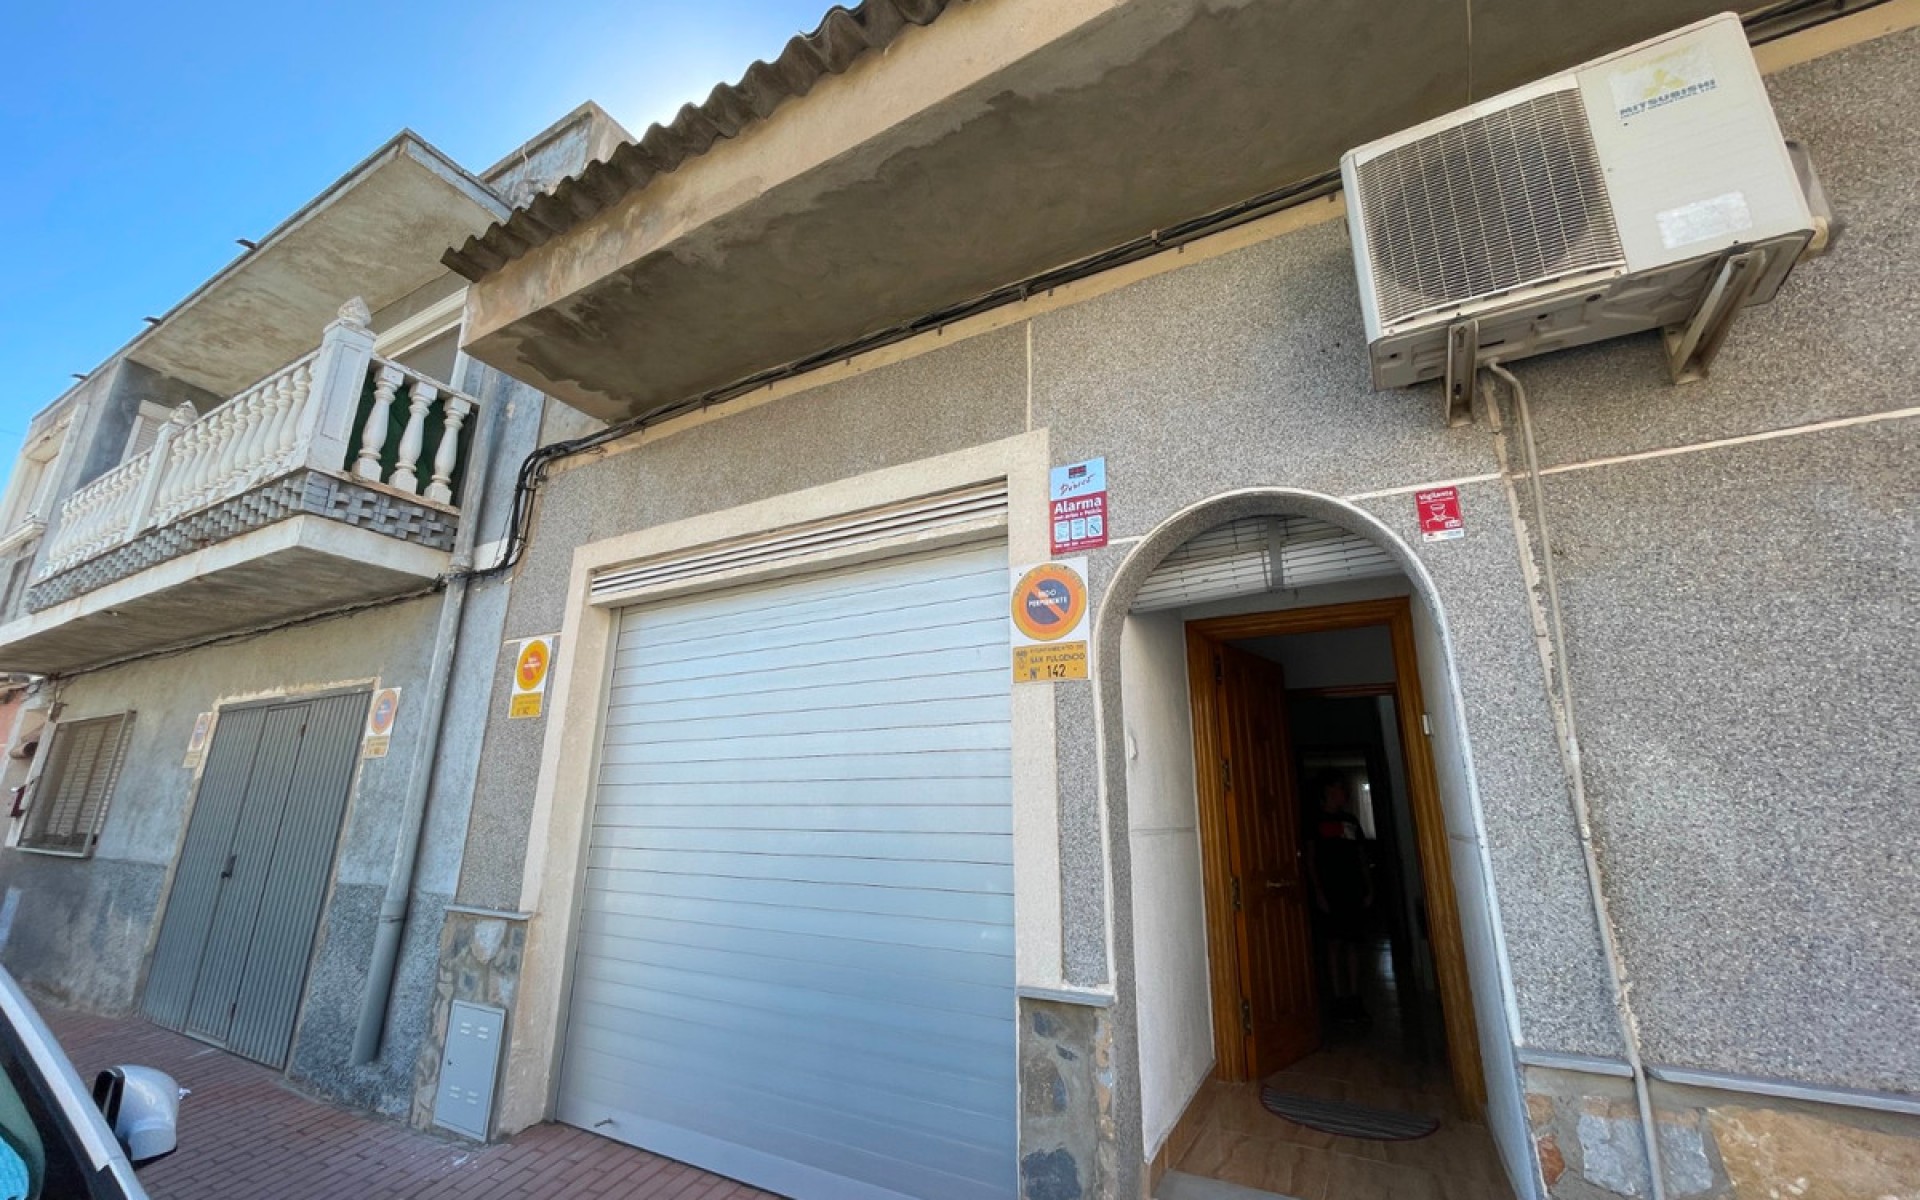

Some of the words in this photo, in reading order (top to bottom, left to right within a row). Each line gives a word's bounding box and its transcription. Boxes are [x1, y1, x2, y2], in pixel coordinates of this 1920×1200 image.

[1620, 79, 1716, 116] MITSUBISHI
[1055, 497, 1102, 513] Alarma
[1047, 664, 1066, 678] 142
